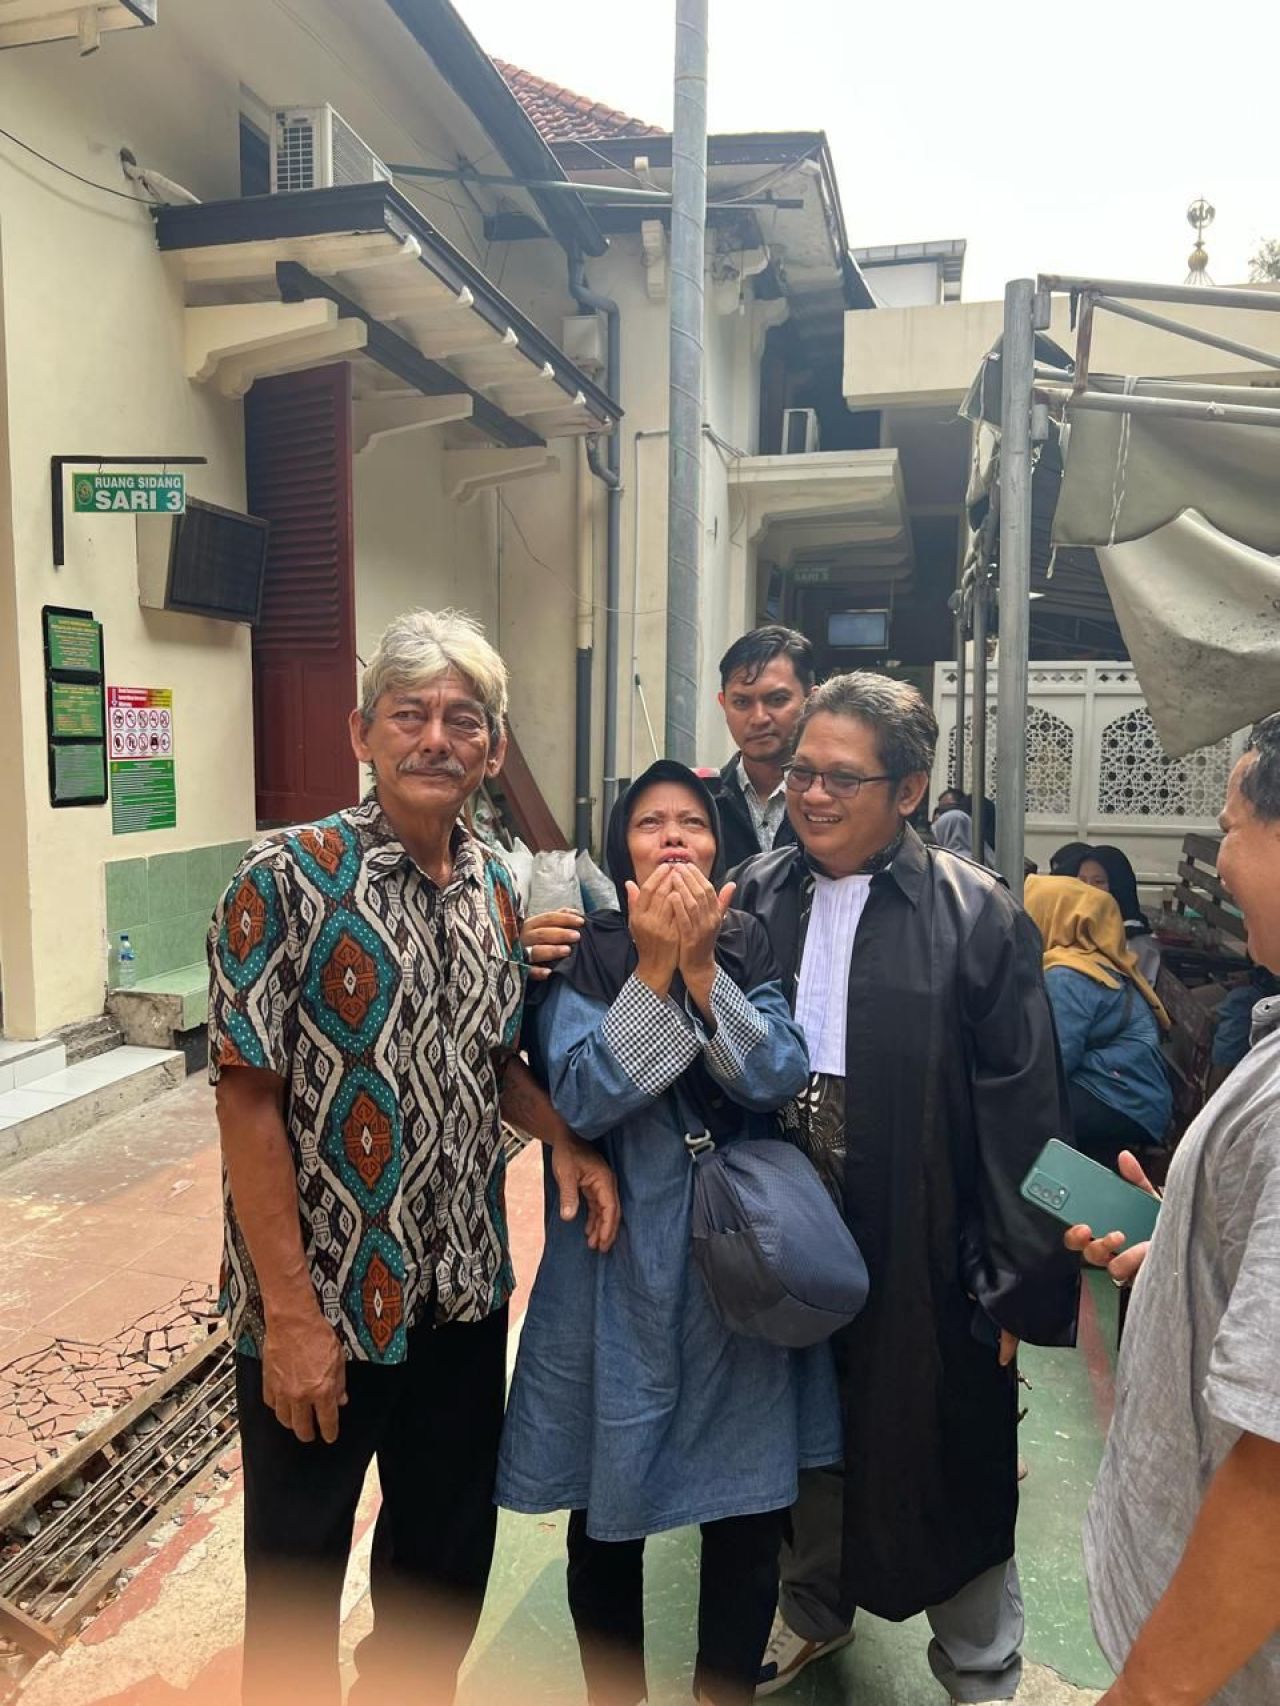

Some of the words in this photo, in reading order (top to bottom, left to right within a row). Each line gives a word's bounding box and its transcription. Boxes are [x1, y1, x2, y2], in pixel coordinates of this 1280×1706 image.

[95, 477, 134, 488] RUANG
[138, 477, 181, 488] SIDANG
[96, 490, 157, 509] SARI
[167, 490, 181, 509] 3
